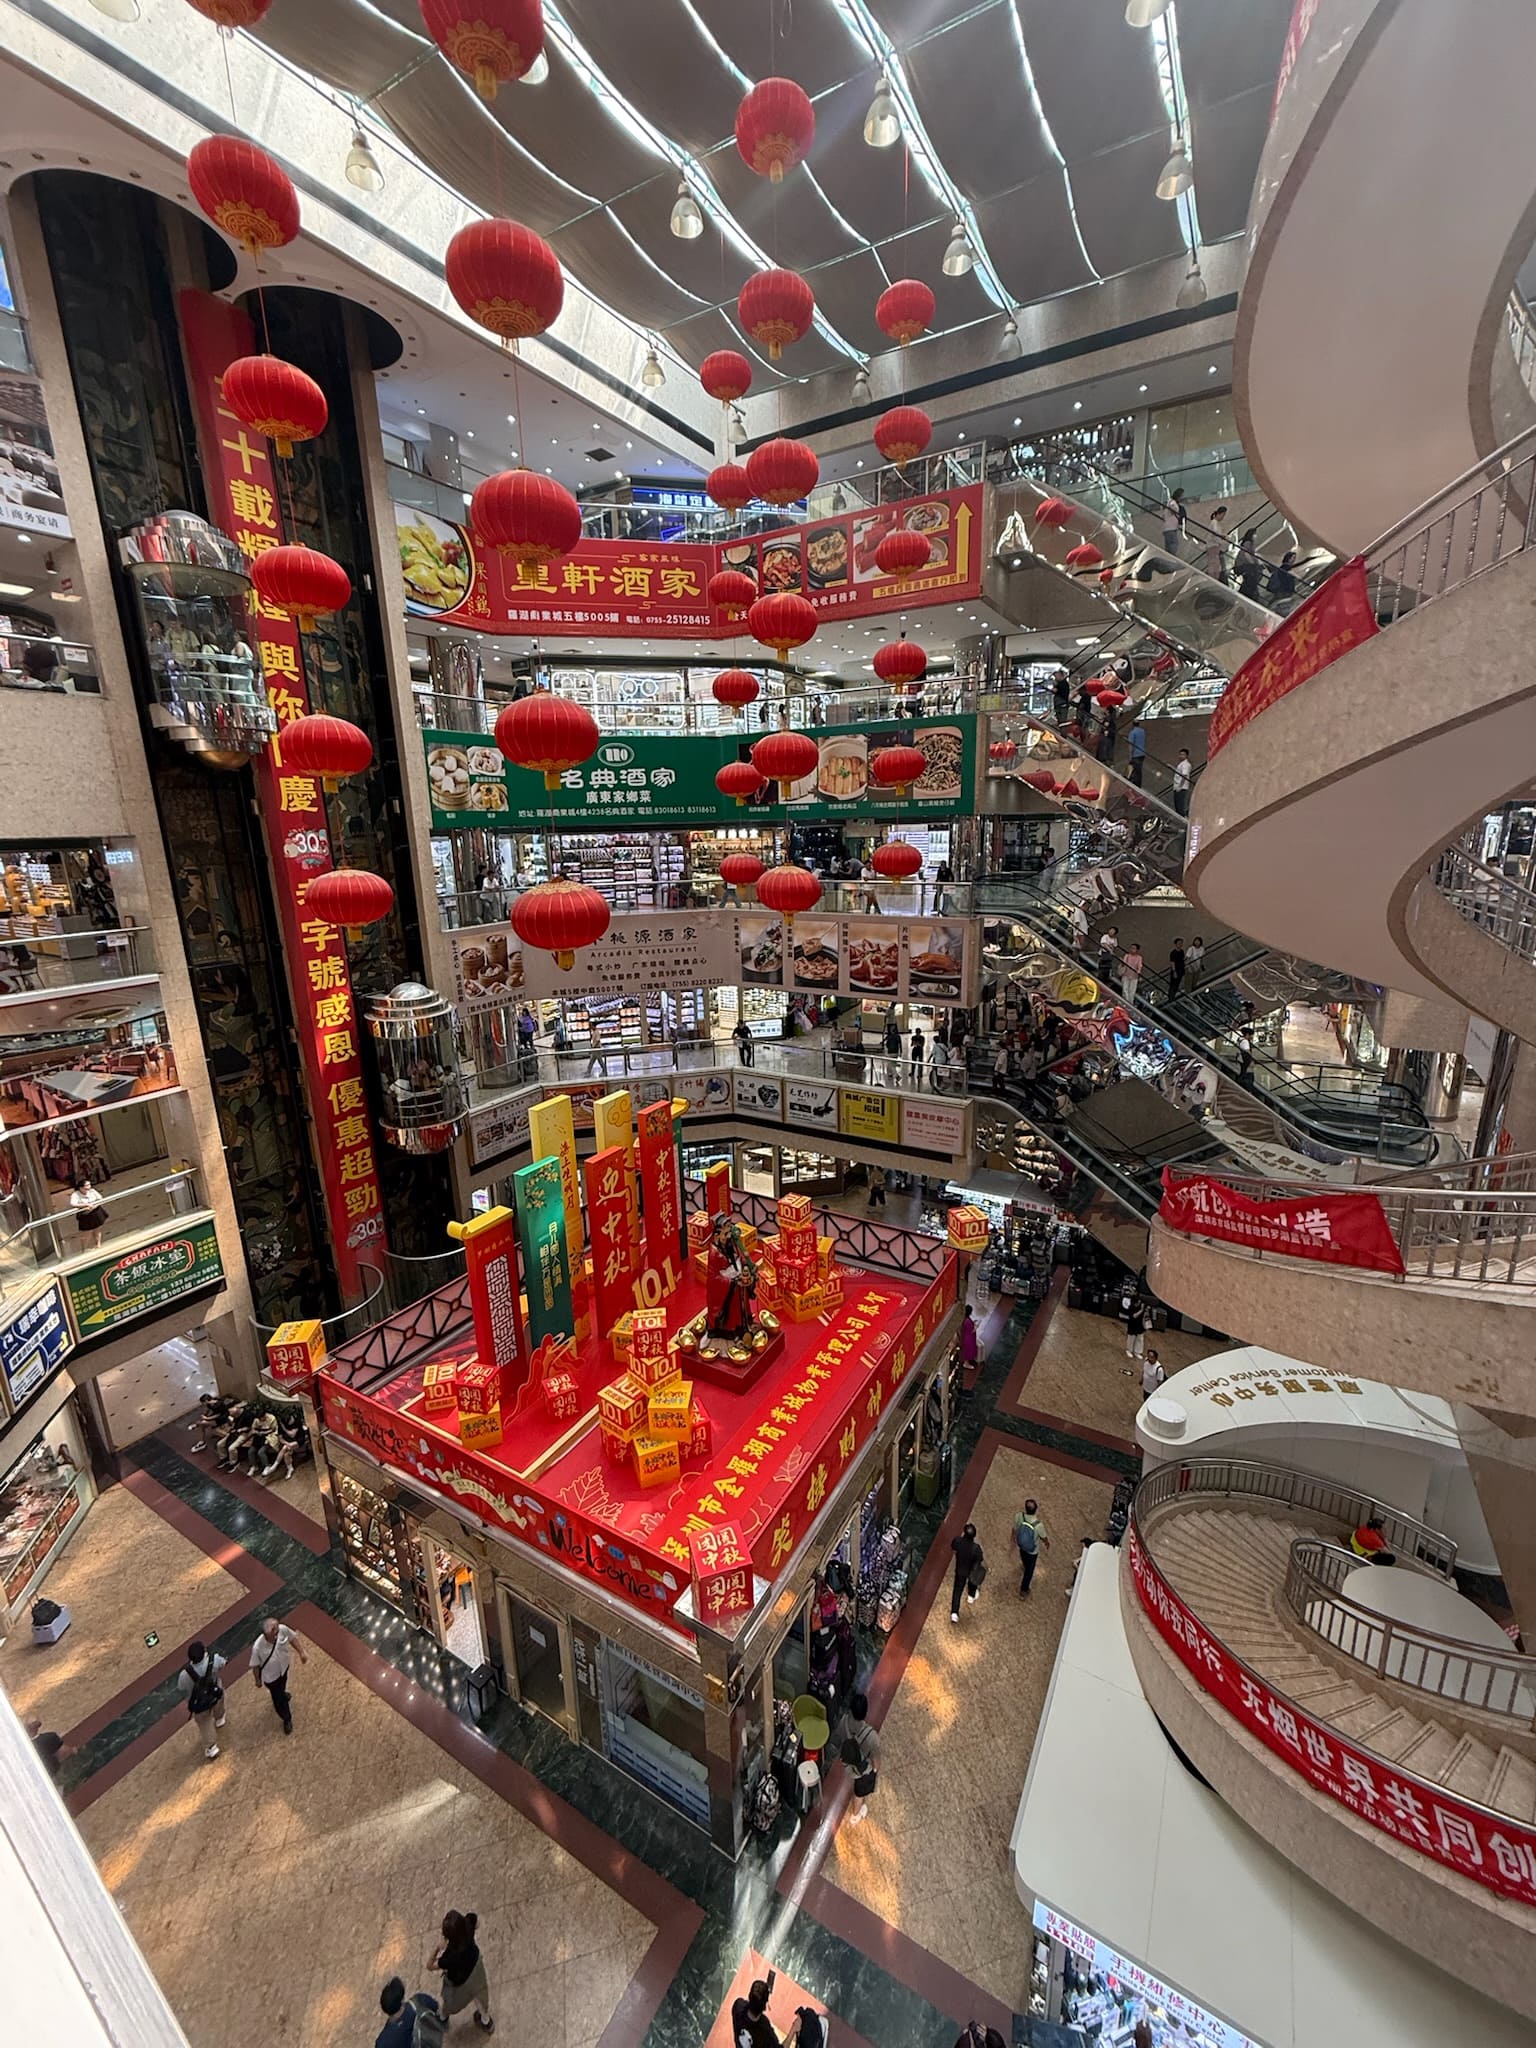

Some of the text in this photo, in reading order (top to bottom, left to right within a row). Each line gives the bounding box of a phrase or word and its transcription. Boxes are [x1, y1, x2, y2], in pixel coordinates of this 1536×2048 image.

[560, 767, 676, 789] 名典酒家
[593, 926, 698, 946] 桃源酒家
[591, 946, 698, 958] Arcadia Restaurant
[328, 1075, 379, 1218] 優惠超勁
[595, 1167, 630, 1288] 迎中秋
[113, 1248, 186, 1287] 茶飯冰室
[632, 1256, 677, 1310] 10.1
[428, 1383, 453, 1399] 10.1
[1189, 1367, 1350, 1397] ustomer Service Center
[696, 1526, 738, 1551] 团圆
[548, 1520, 652, 1600] Welcome
[702, 1547, 746, 1571] 中秋
[707, 1570, 746, 1596] 团圆
[708, 1591, 750, 1615] 中秋
[1110, 1954, 1227, 2037] 手機維修中心
